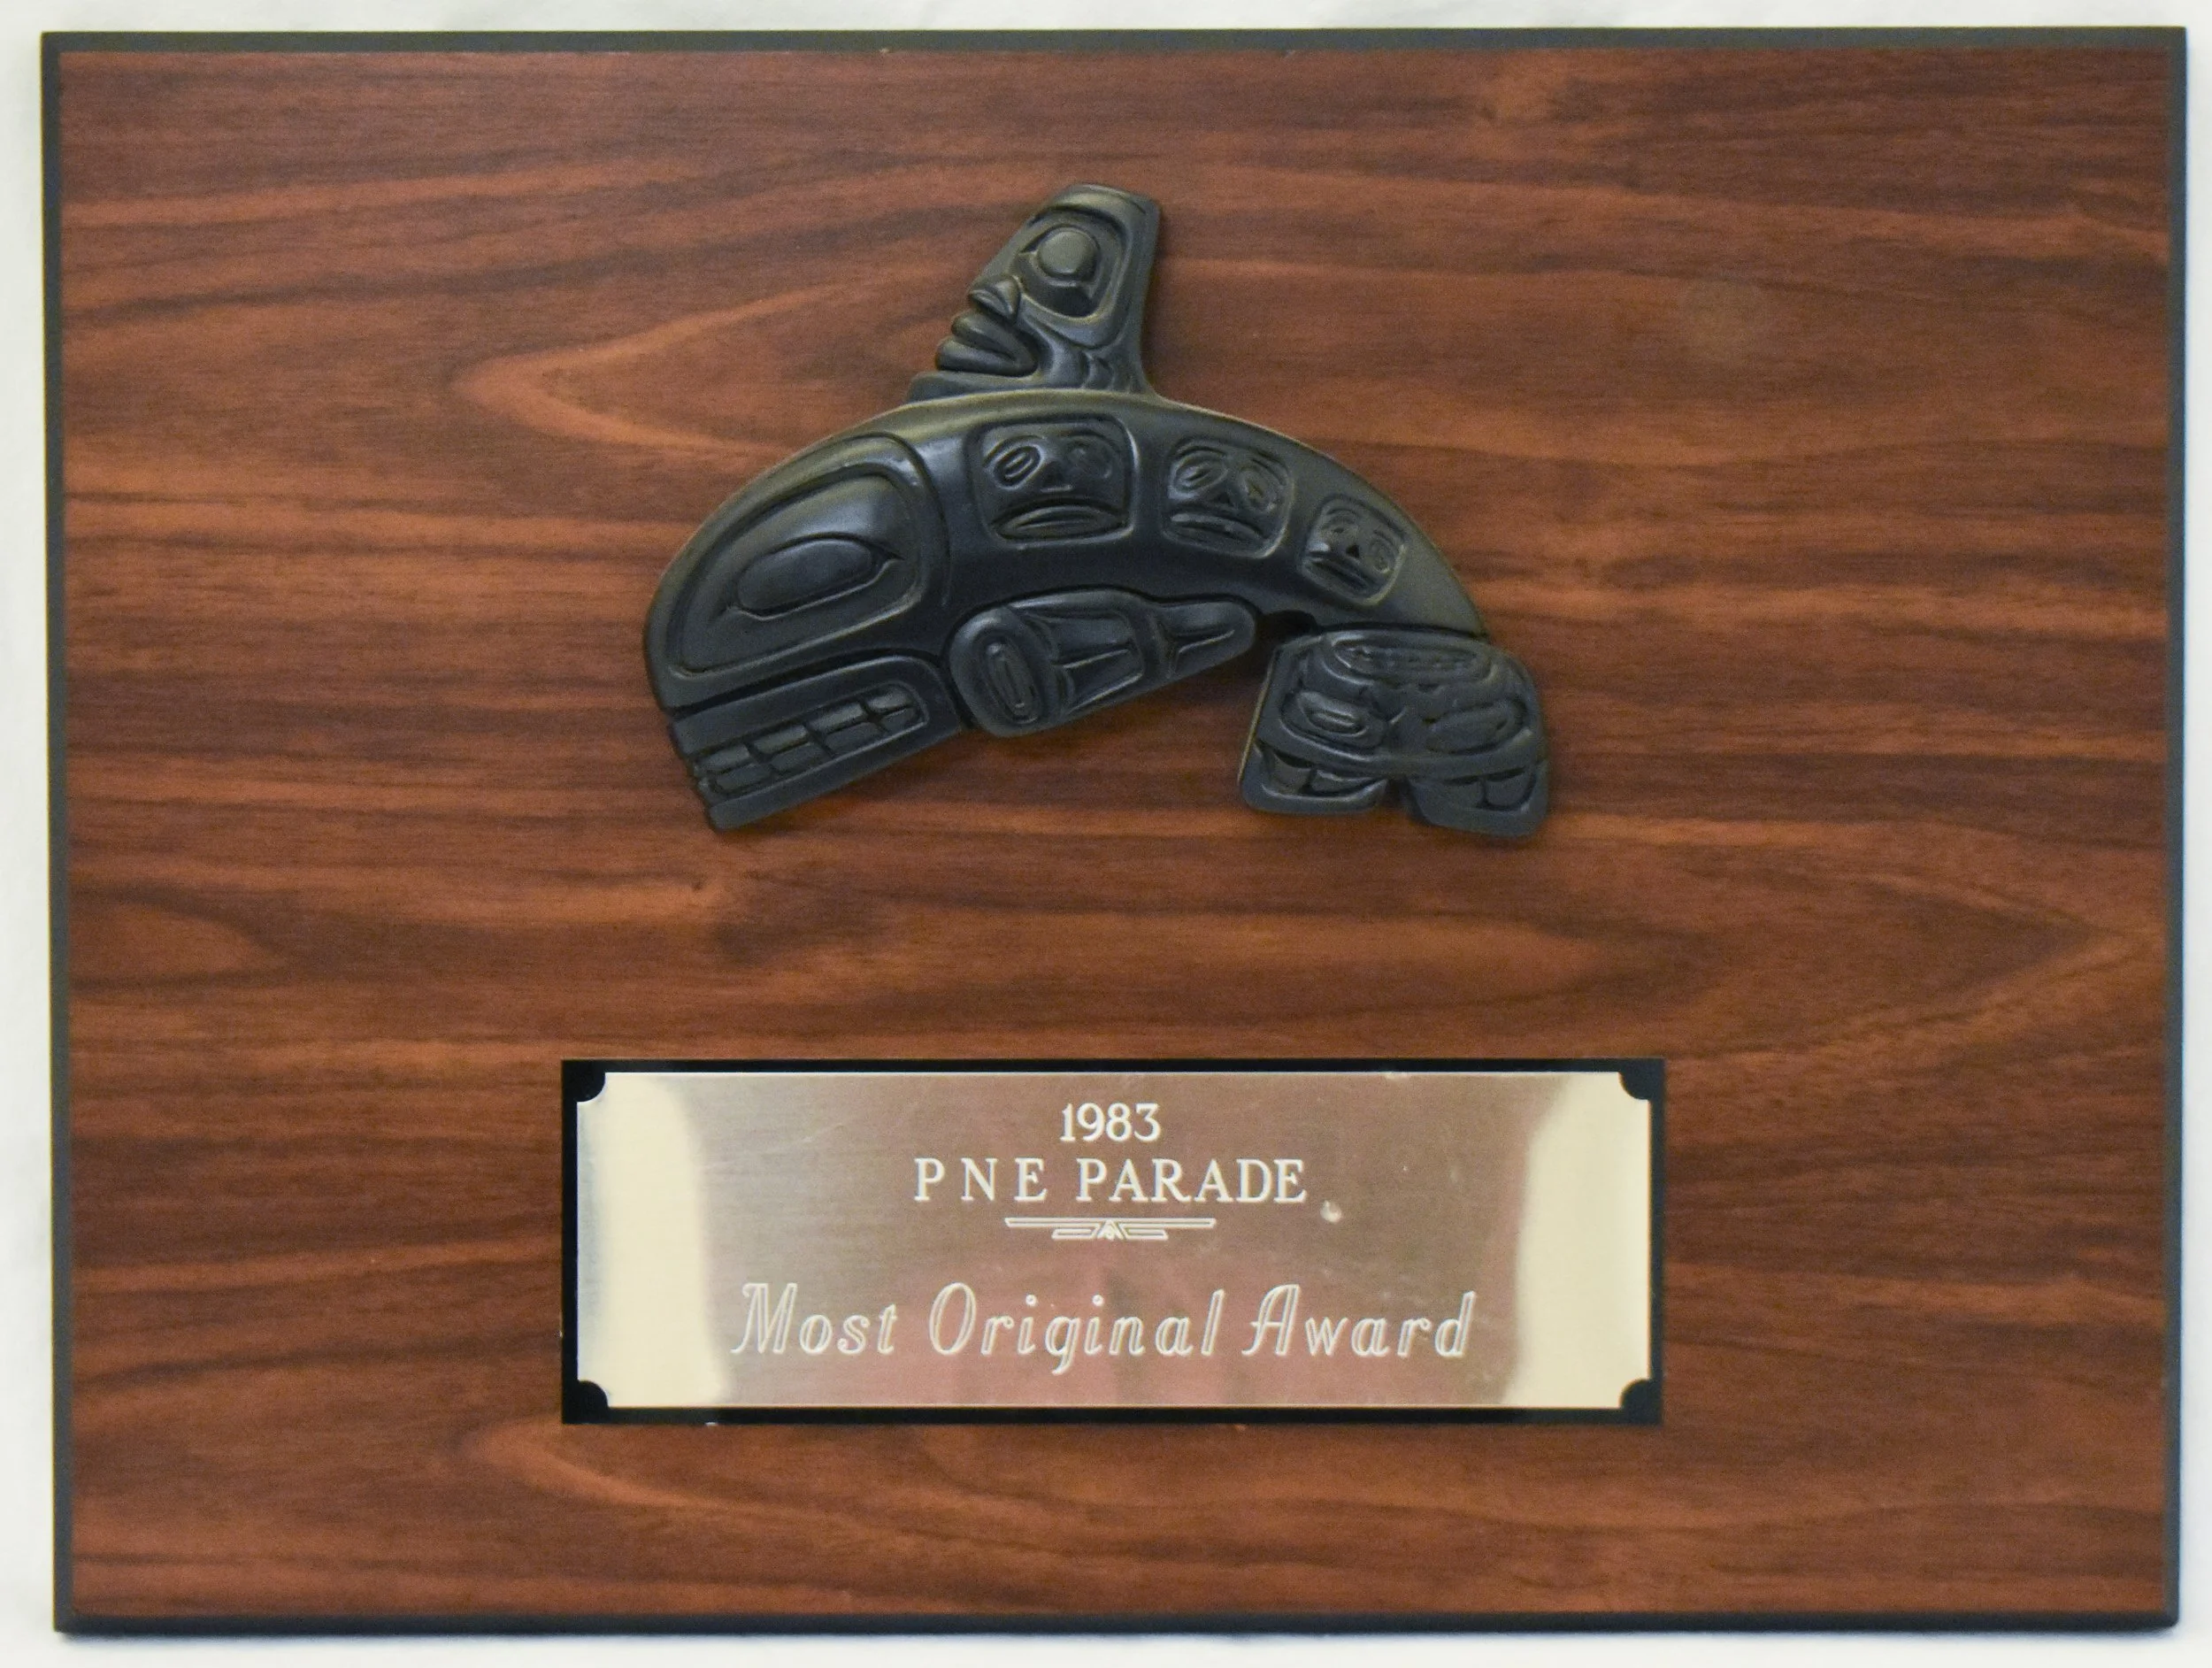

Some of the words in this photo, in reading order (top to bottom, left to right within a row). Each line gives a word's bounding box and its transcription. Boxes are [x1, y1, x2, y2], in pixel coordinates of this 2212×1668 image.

[1059, 1102, 1162, 1142] 1983
[1075, 1157, 1308, 1203] PARADE
[730, 1281, 898, 1356] Most
[928, 1281, 1225, 1376] Original
[1240, 1283, 1478, 1358] Award
